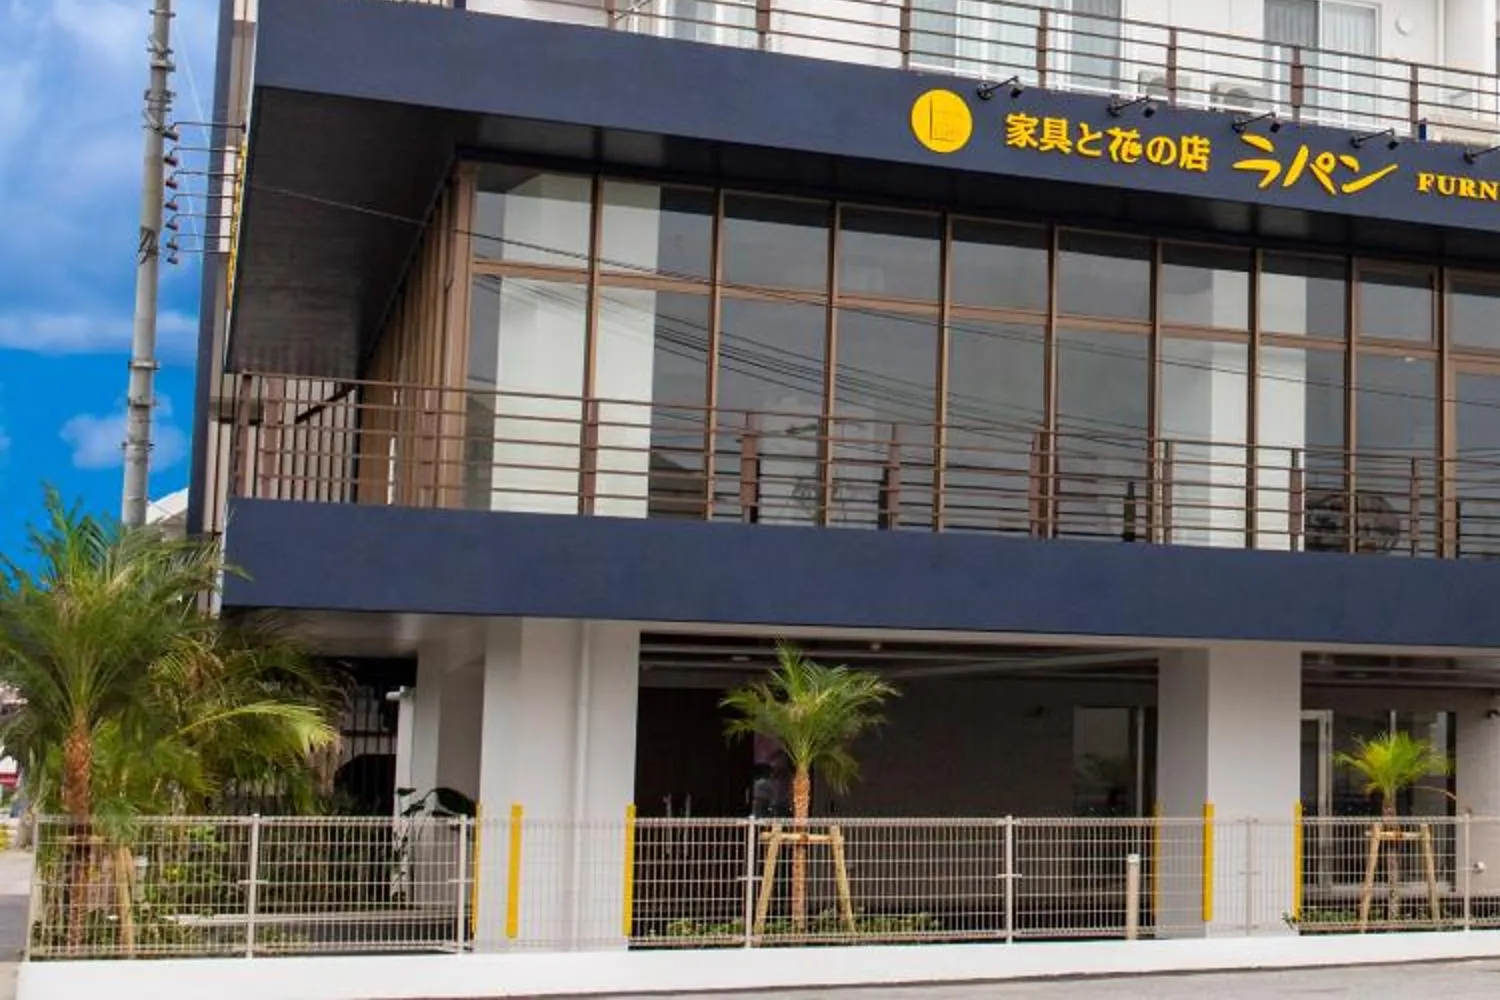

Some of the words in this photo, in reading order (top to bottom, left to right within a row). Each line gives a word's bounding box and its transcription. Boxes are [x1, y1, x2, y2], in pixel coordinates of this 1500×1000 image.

[1005, 112, 1211, 172] 家具と花の店
[1232, 134, 1399, 196] ラパン
